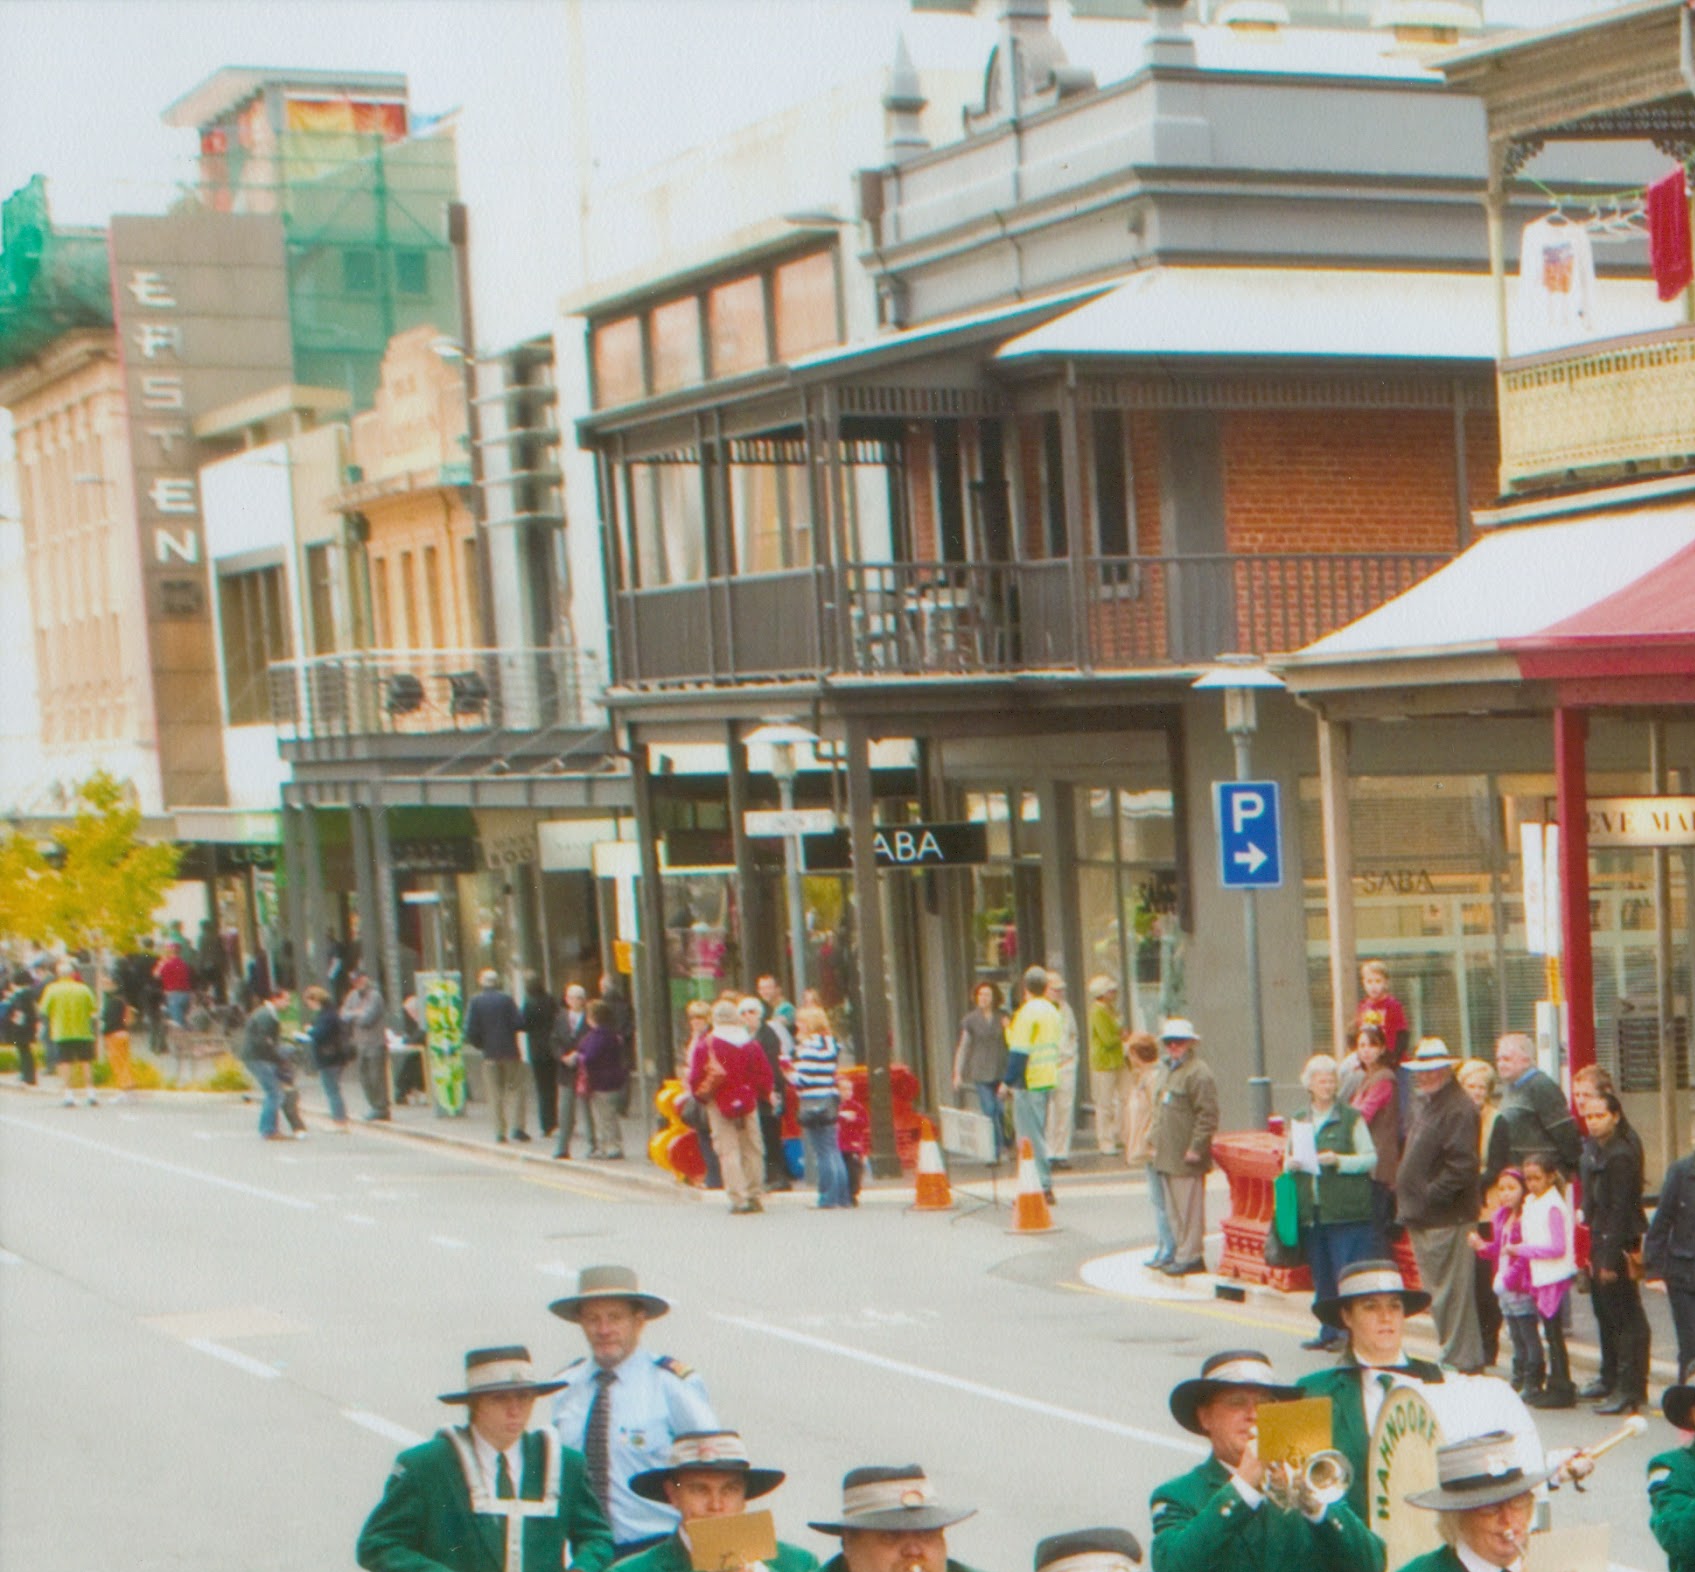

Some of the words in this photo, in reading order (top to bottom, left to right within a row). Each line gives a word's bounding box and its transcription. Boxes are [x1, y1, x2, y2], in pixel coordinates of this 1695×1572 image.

[1231, 791, 1265, 834] P
[851, 831, 944, 863] ABA
[1362, 868, 1435, 894] SABA
